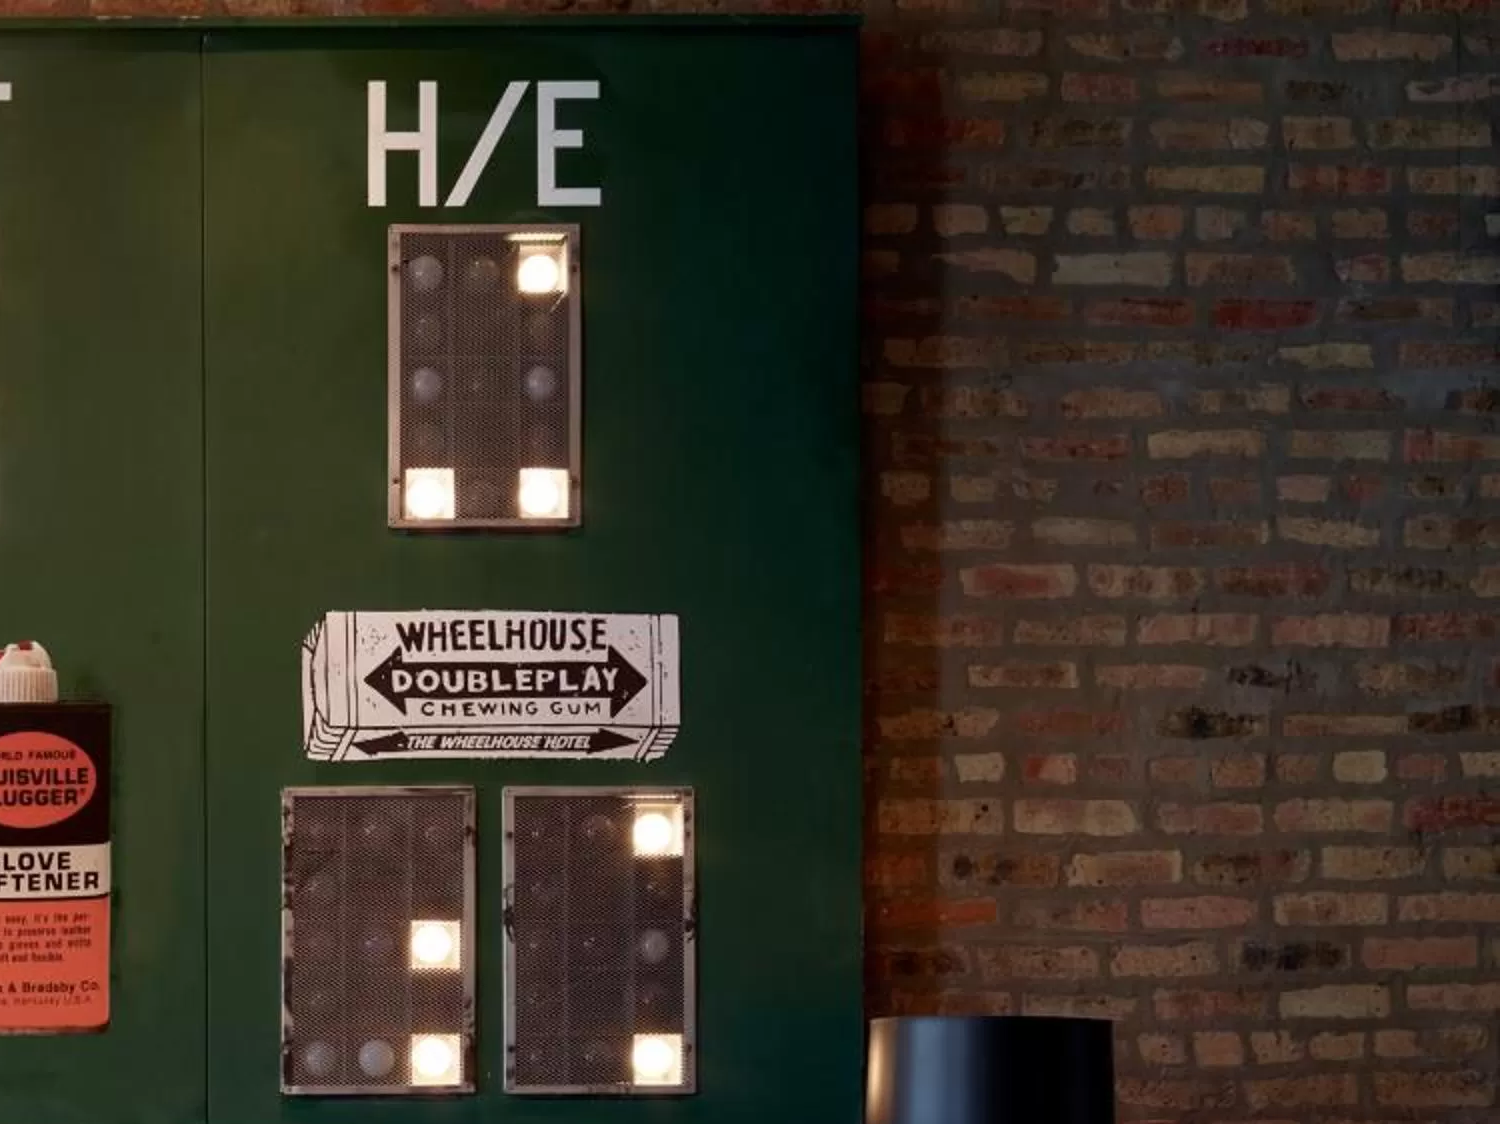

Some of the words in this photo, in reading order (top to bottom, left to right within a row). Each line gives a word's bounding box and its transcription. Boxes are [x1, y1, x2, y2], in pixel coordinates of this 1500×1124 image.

[367, 79, 602, 207] H/E
[395, 617, 609, 653] WHEELHOUSE
[390, 667, 621, 694] DOUBLEPLAY
[420, 701, 538, 717] CHEWING
[550, 701, 602, 716] GUM
[406, 736, 438, 750] THE
[440, 735, 544, 750] WHEELHOUSE
[544, 735, 592, 750] HOTEL
[28, 749, 77, 761] FAMOUS
[8, 982, 17, 993] &
[21, 981, 76, 995] Bradsby
